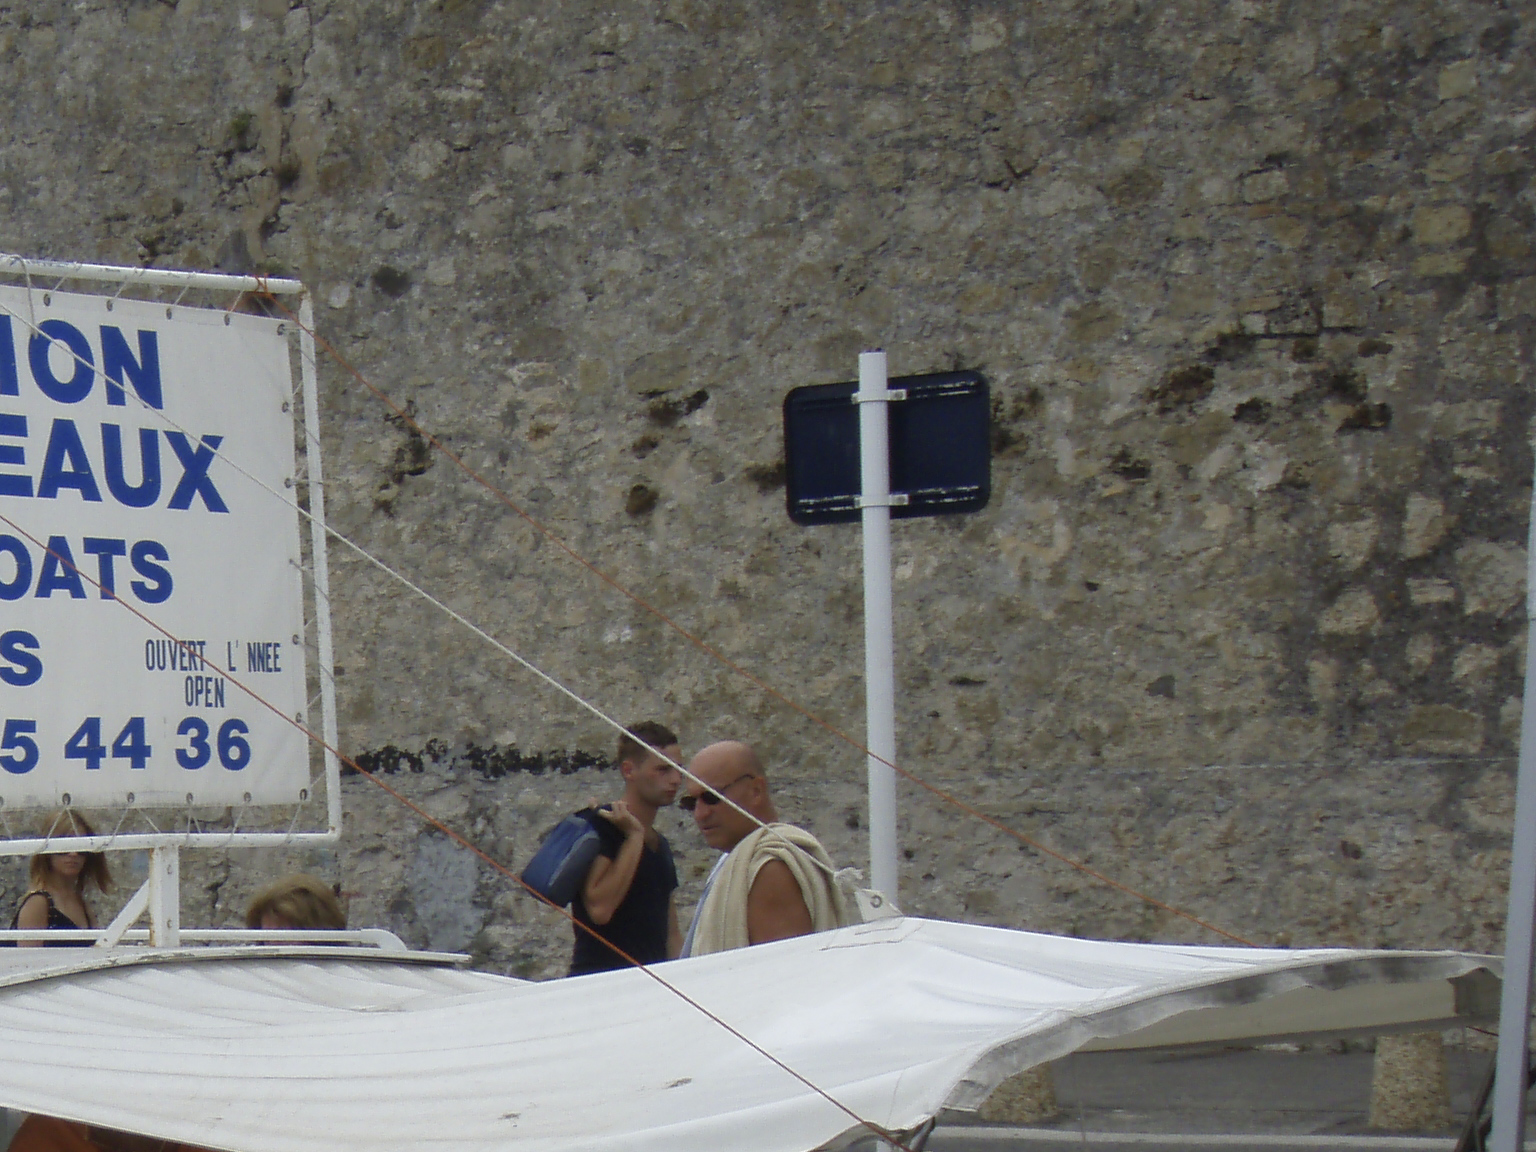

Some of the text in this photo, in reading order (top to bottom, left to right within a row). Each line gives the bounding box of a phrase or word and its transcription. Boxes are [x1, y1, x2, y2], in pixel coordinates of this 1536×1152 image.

[145, 638, 206, 672] OUVERT
[184, 675, 225, 708] OPEN
[64, 716, 152, 770] 44
[175, 716, 252, 771] 36
